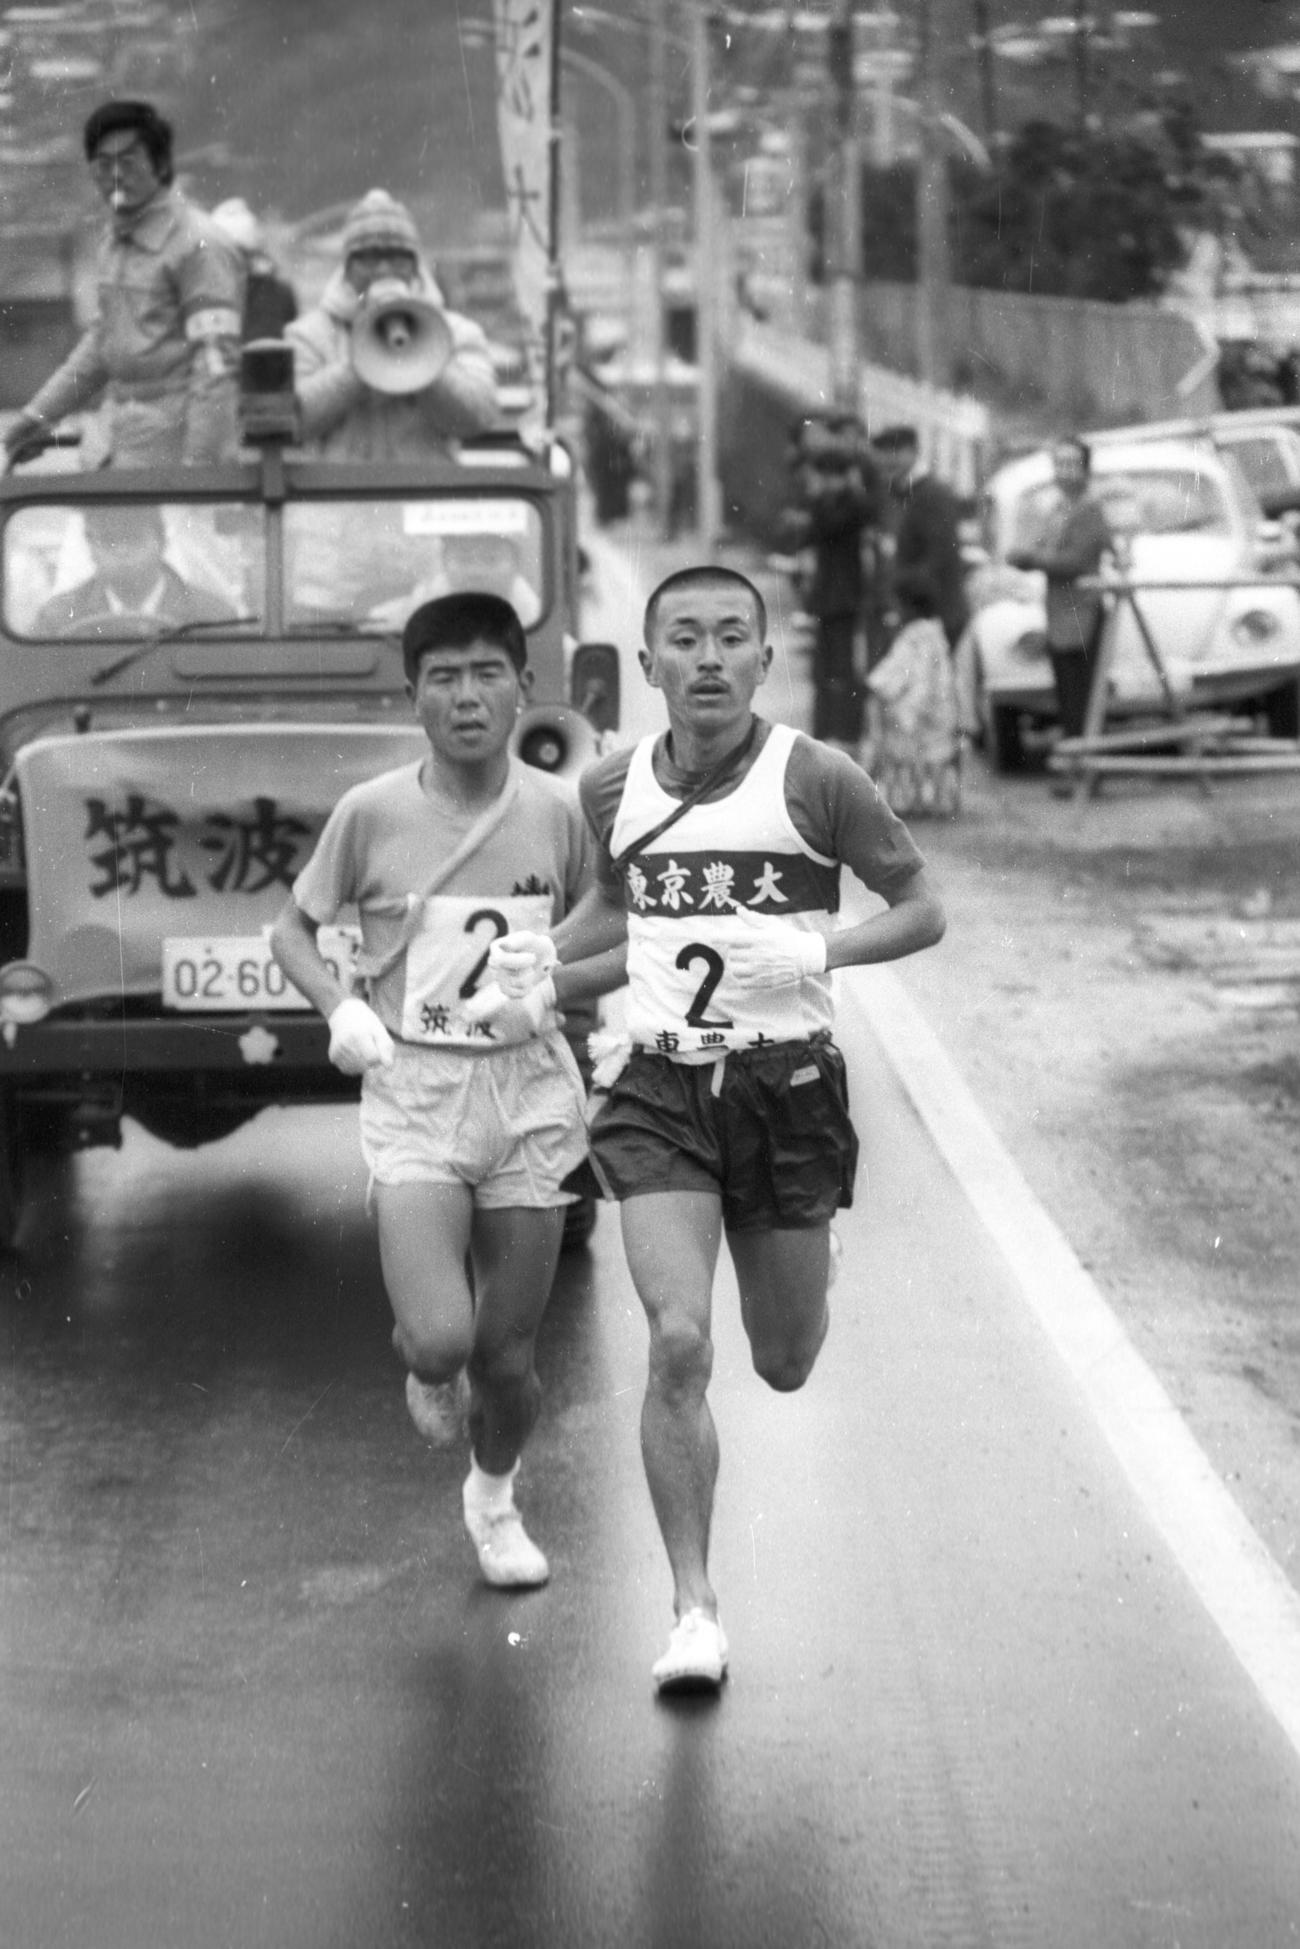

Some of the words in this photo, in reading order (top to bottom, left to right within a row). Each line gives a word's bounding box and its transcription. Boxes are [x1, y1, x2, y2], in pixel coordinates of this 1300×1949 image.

[626, 859, 789, 910] 東京農大
[459, 908, 508, 999] 2
[675, 942, 734, 1028] 2
